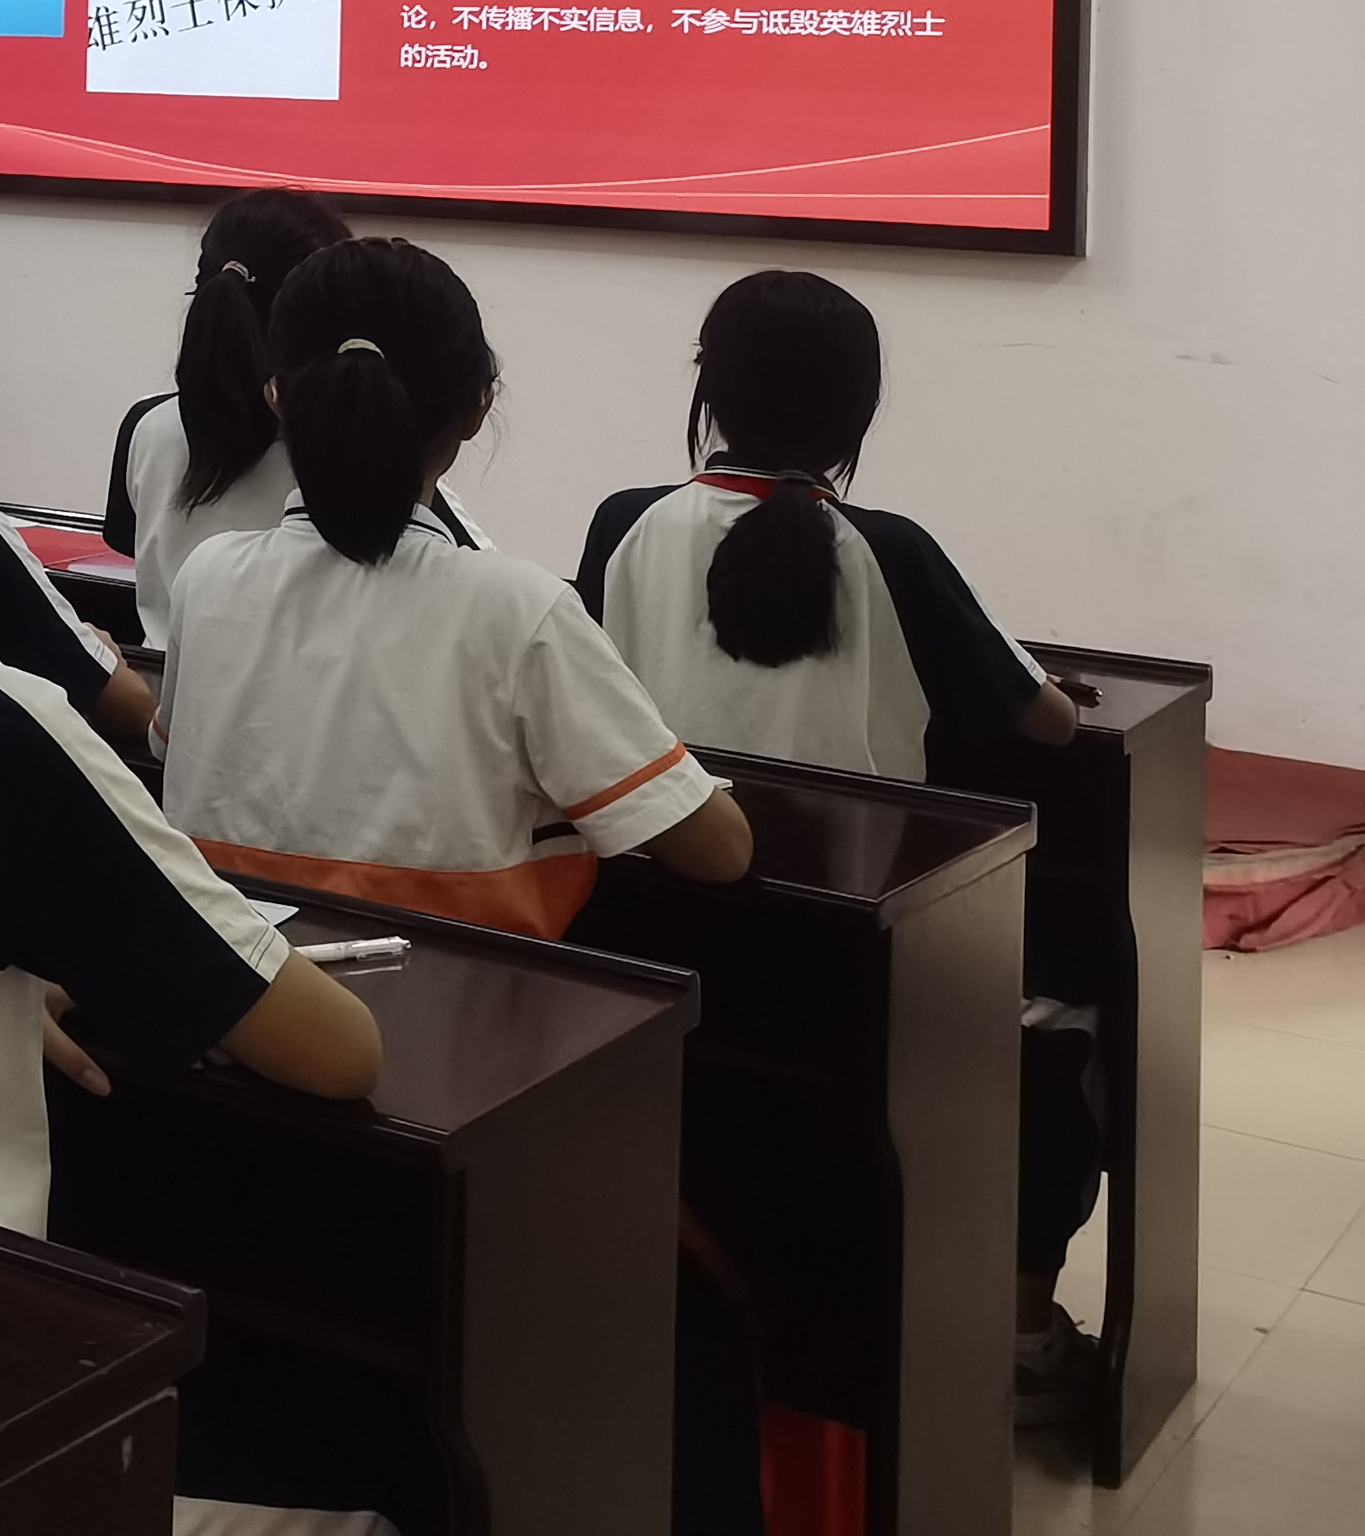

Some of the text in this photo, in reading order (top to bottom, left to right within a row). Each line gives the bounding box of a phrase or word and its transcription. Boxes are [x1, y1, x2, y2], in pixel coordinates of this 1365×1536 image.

[399, 4, 947, 37] 论，不传播不实信息，不参与诋毁英雄烈士
[400, 43, 488, 70] 的活动。
